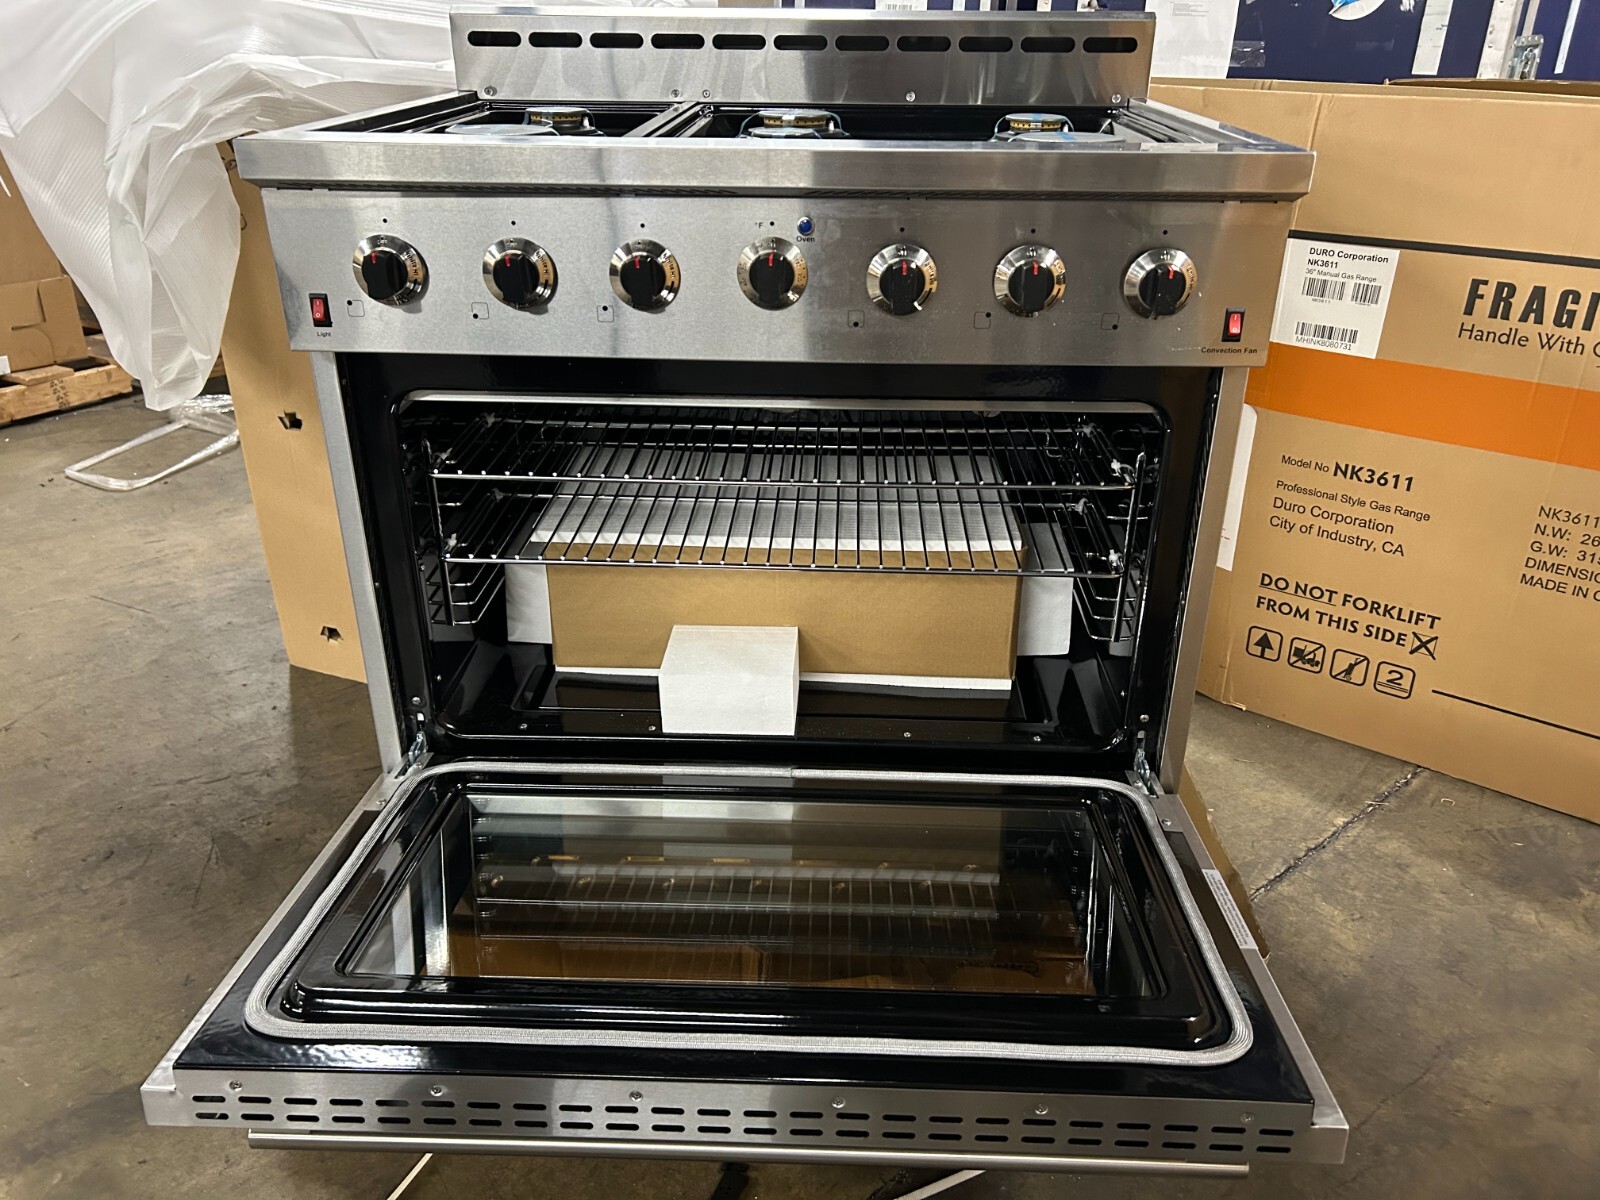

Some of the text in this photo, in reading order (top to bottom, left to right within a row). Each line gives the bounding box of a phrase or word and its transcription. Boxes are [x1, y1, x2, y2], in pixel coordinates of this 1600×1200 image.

[1307, 258, 1338, 269] NK3611
[1309, 248, 1389, 263] DURO Corporation
[1356, 274, 1377, 283] Range
[1462, 278, 1600, 332] FRAGI
[1457, 322, 1529, 347] Handle
[1538, 332, 1586, 355] With
[1281, 454, 1415, 492] Model No NK3611
[1273, 497, 1394, 534] Duro Corporation
[1276, 480, 1431, 522] Professional Style Gas Range
[1538, 505, 1600, 528] NK3611
[1269, 515, 1405, 557] City of Industry, CA
[1534, 523, 1572, 541] N.W:
[1530, 540, 1568, 558] G.W:
[1520, 573, 1568, 594] MADE
[1571, 585, 1589, 599] IN
[1259, 572, 1441, 630] DO NOT FORKLIFT
[1256, 595, 1408, 647] FROM THIS SIDE
[1386, 669, 1404, 687] 2
